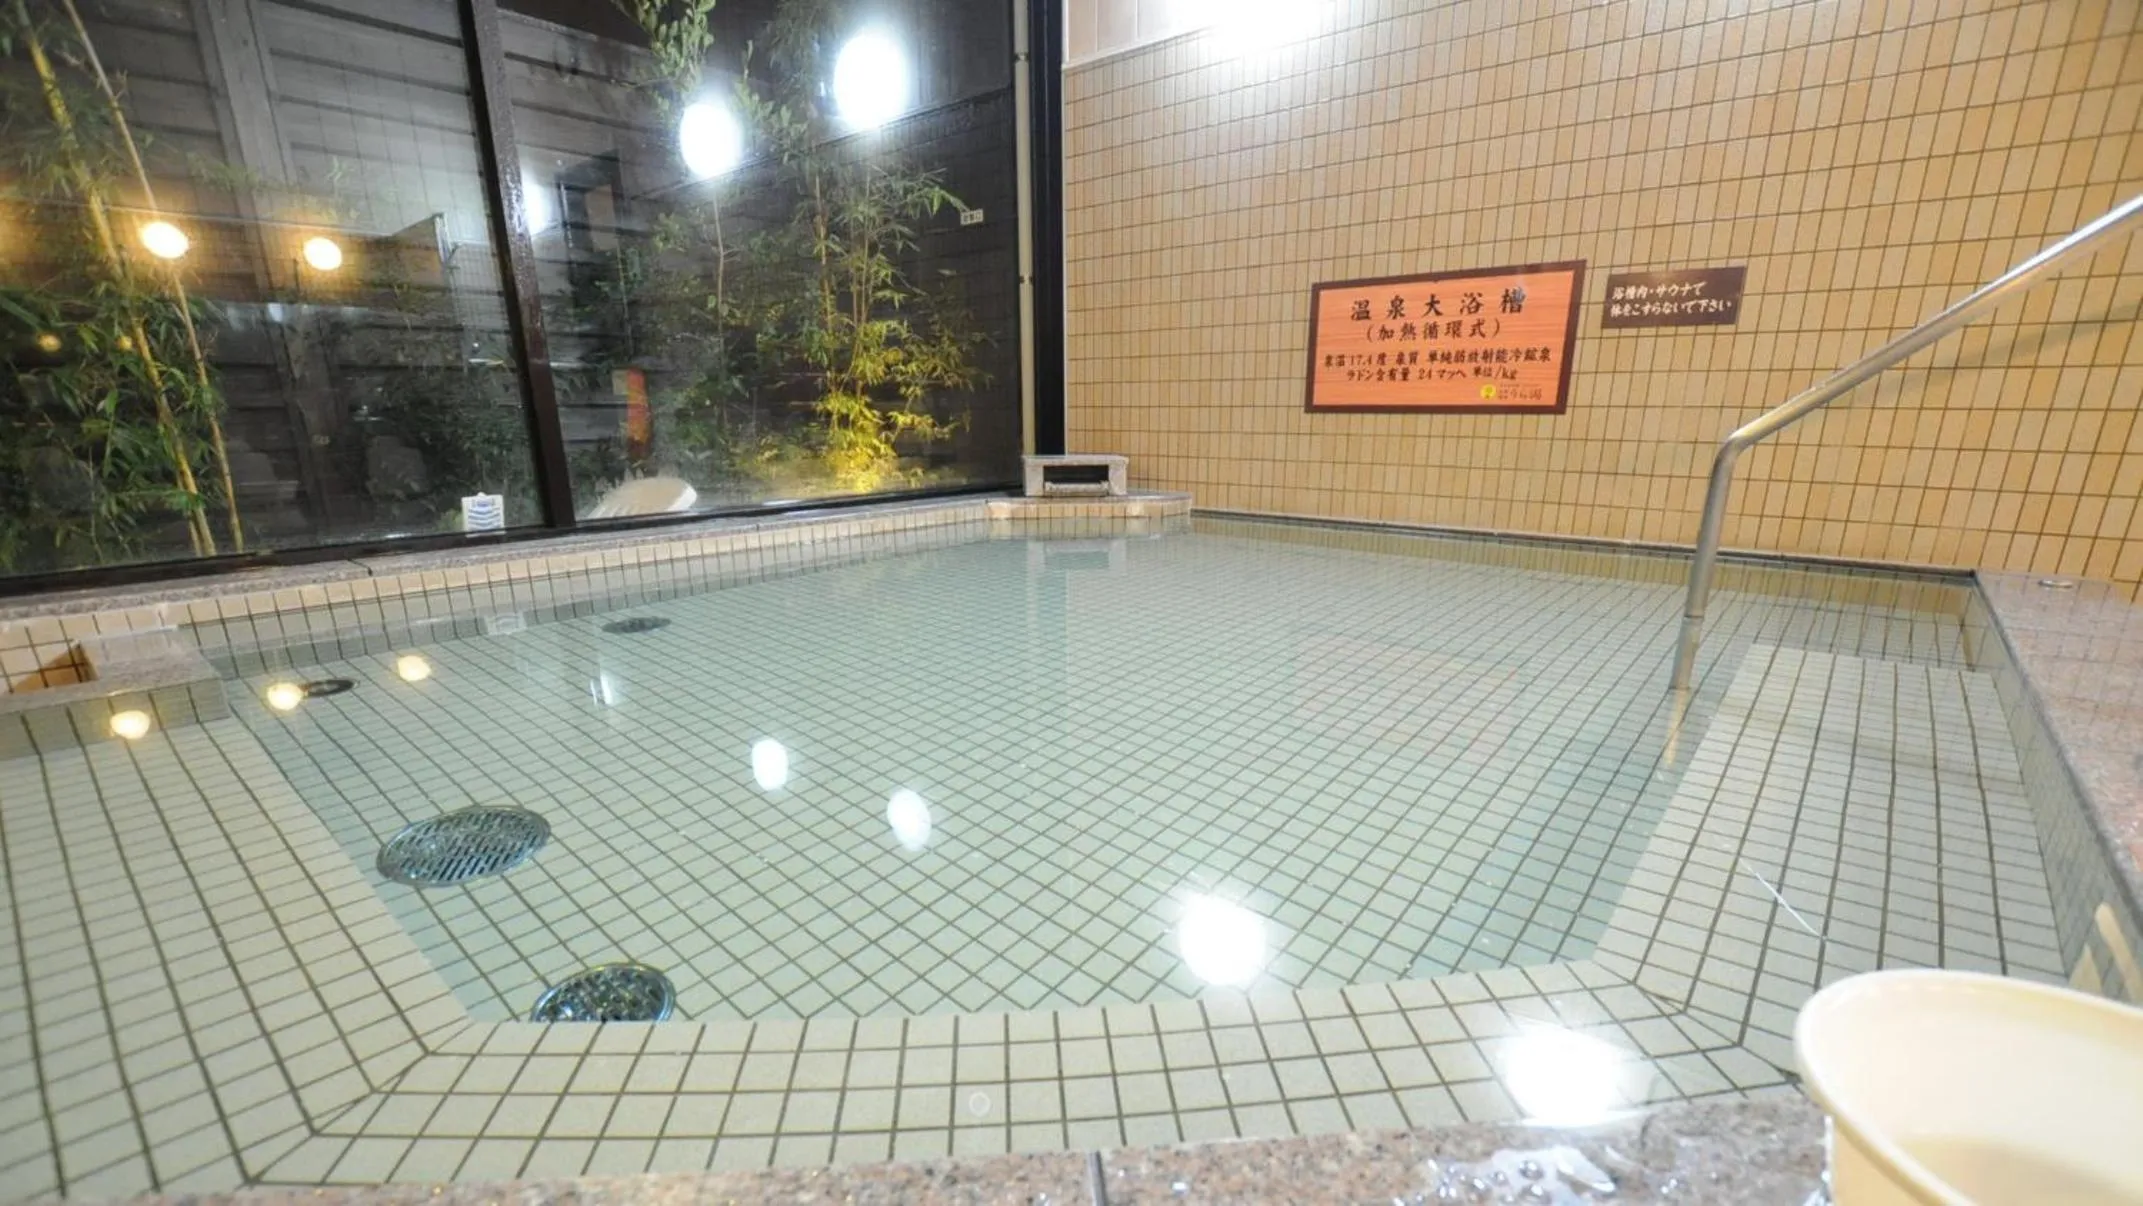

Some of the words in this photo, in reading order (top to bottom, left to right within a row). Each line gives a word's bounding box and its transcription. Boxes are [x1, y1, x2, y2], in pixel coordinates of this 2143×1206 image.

[1350, 286, 1526, 321] 温泉大浴槽
